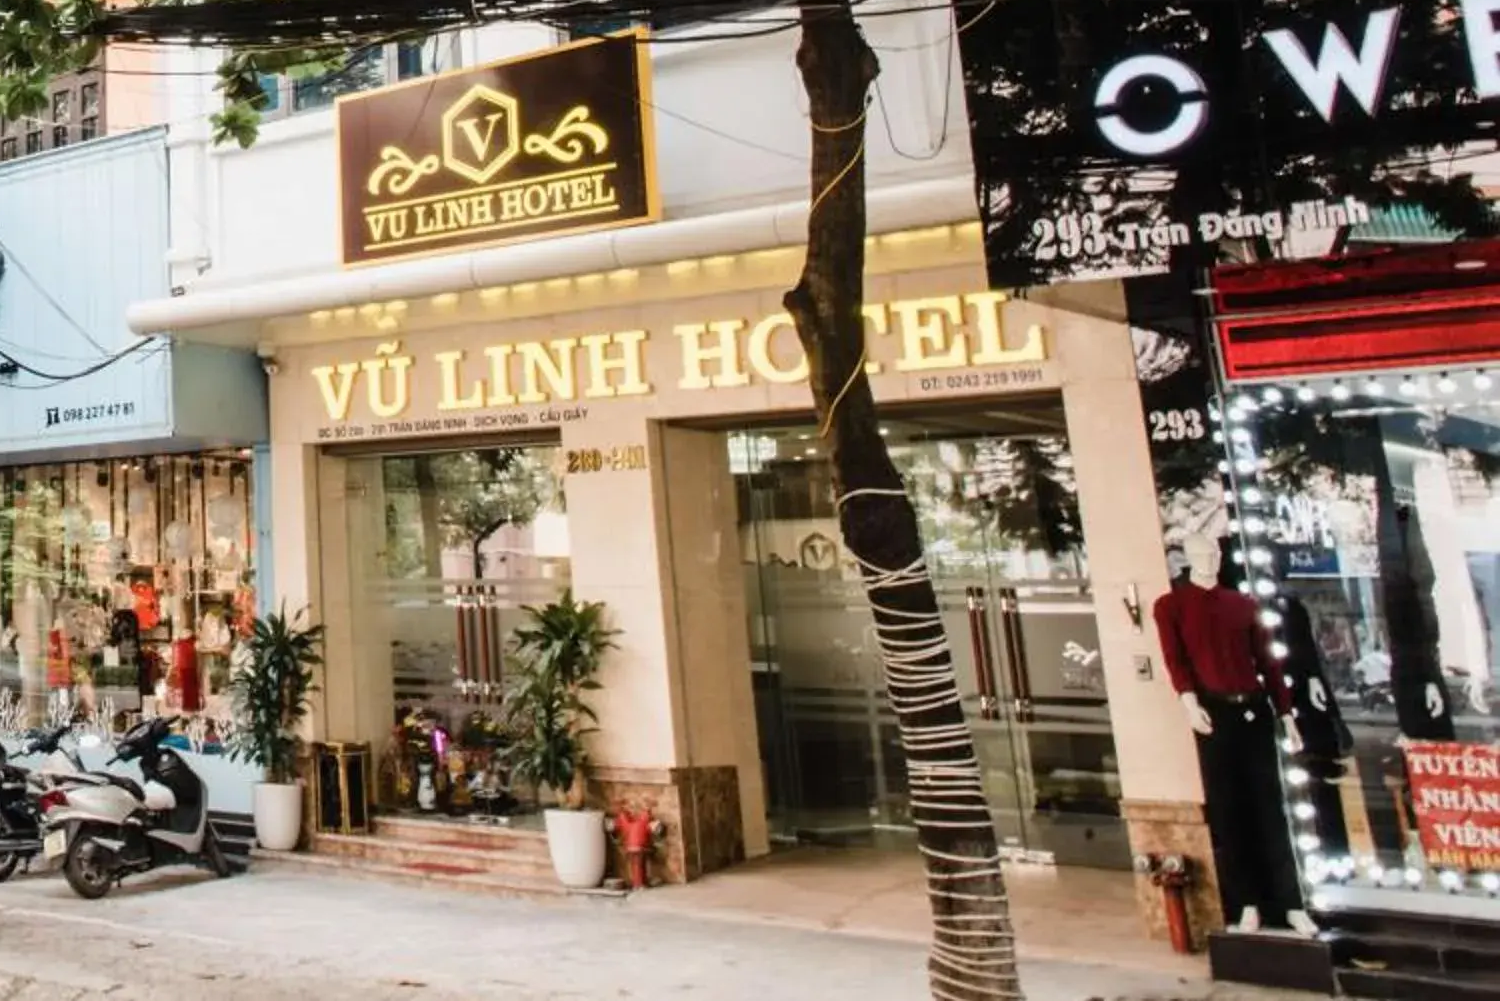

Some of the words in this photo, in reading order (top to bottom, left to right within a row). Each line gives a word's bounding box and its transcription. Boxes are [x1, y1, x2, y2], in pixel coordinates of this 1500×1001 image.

[457, 113, 503, 161] V
[414, 192, 495, 234] LINH
[500, 173, 616, 221] HOTEL
[1033, 209, 1106, 260] 293
[311, 340, 414, 421] VŨ
[434, 329, 653, 412] LINH
[1149, 407, 1204, 441] 293
